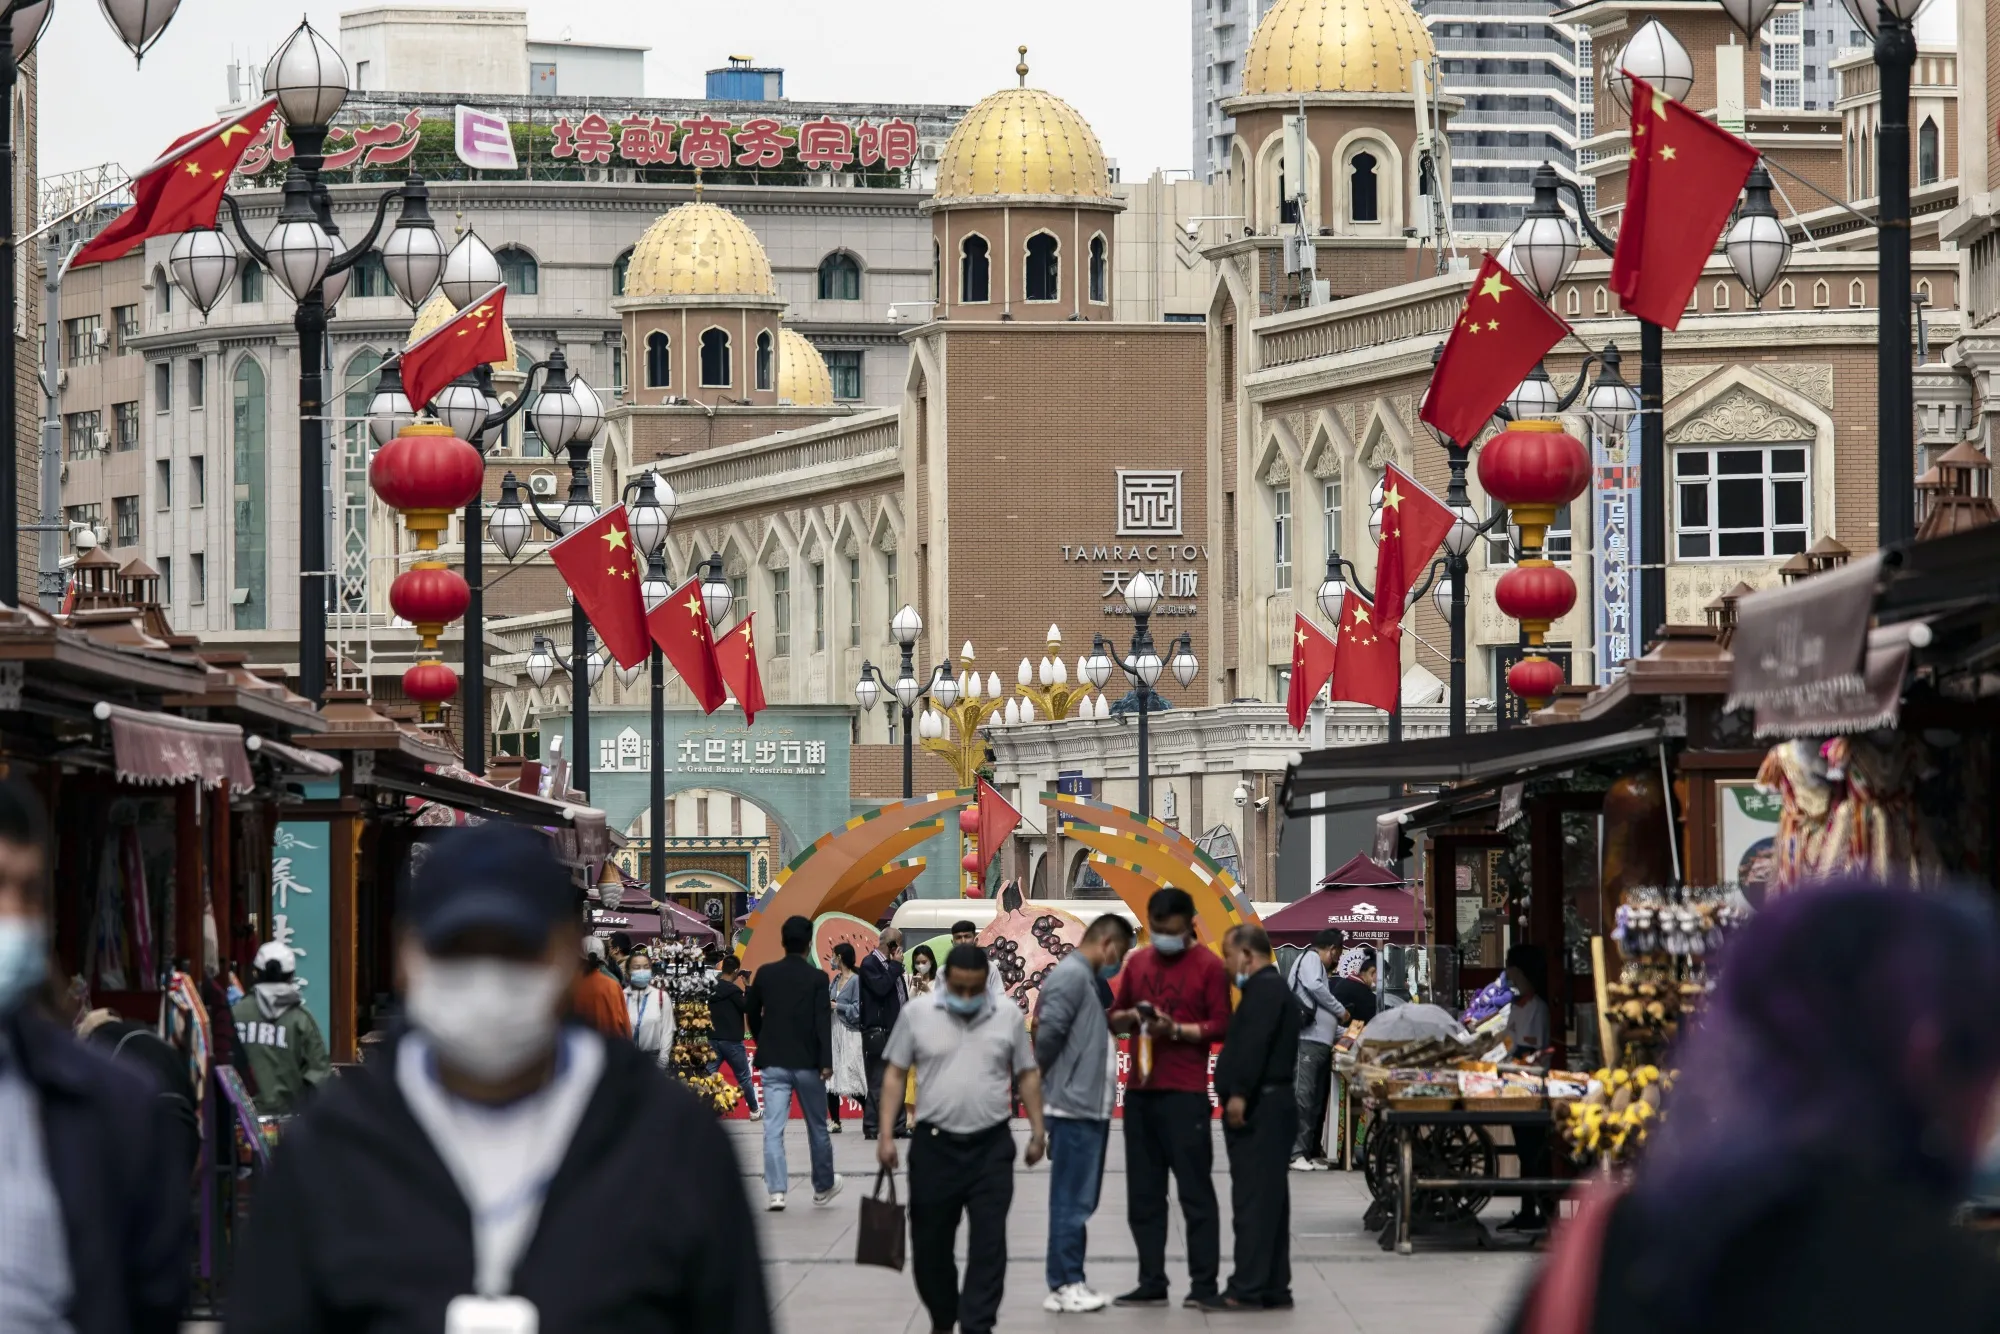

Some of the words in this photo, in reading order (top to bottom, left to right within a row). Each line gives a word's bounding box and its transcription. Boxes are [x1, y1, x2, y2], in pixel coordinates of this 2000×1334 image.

[551, 113, 917, 170] 埃敏商务宾馆
[1062, 545, 1158, 561] TAMRAC
[678, 739, 826, 764] 大巴扎步行街
[687, 765, 713, 773] Grand
[716, 765, 744, 773] Bazaar
[749, 766, 793, 774] Pedestrian
[796, 766, 816, 774] Mall
